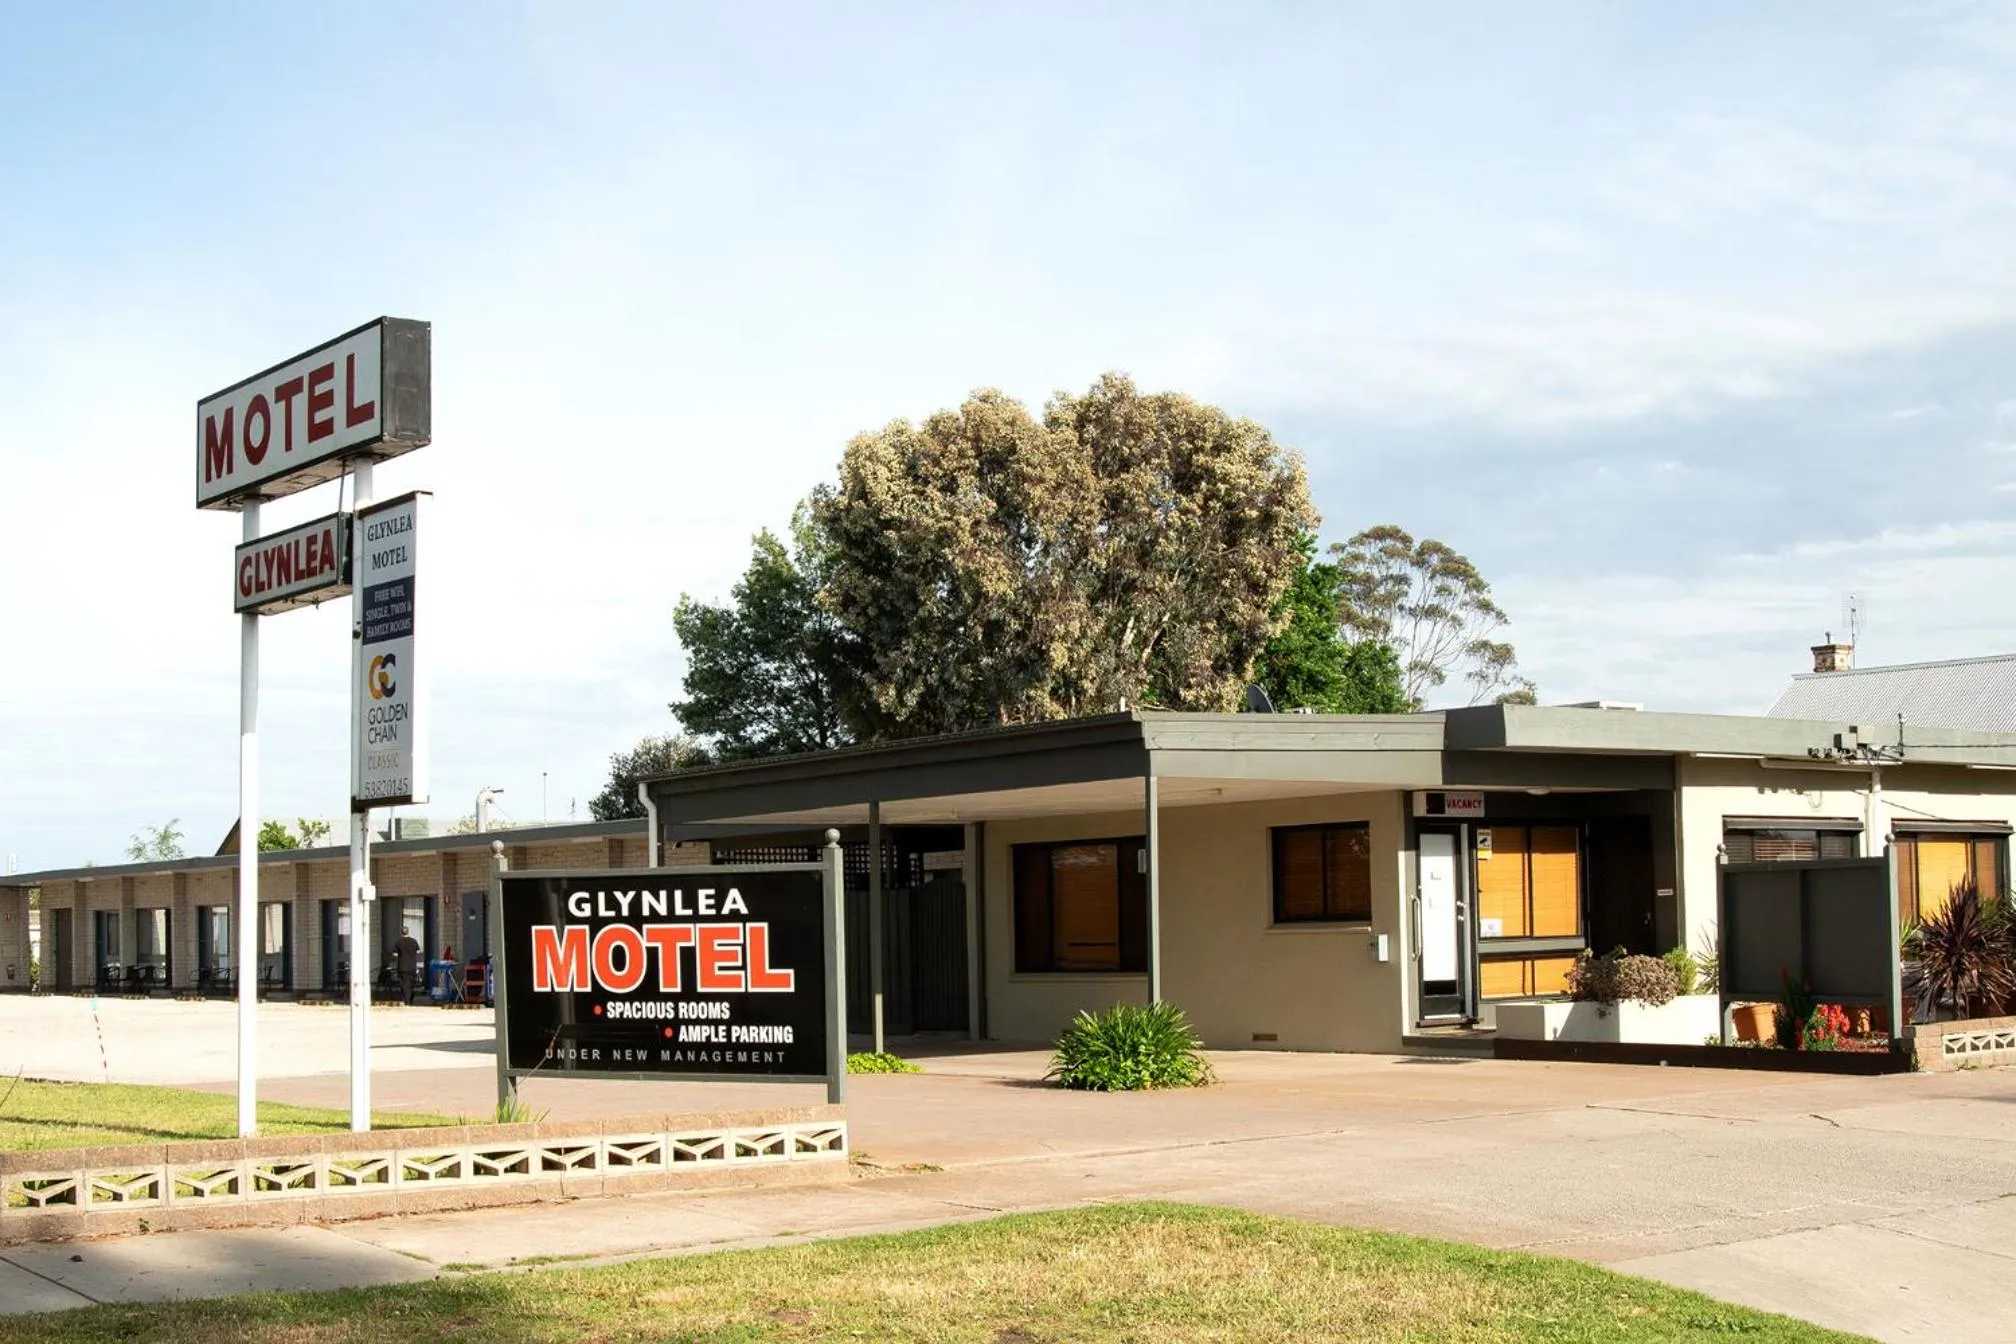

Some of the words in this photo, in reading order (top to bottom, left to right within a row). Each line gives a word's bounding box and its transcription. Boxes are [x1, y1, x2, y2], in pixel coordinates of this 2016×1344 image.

[205, 352, 375, 484] MOTEL
[367, 514, 413, 542] GLYNLEA
[239, 528, 336, 598] GLYNLEA
[372, 546, 408, 570] MOTEL
[368, 703, 408, 725] GOLDEN
[368, 725, 398, 744] CHAIN
[1446, 799, 1482, 809] VACANCY
[568, 888, 749, 917] GLYNLEA
[531, 922, 795, 993] MOTEL
[606, 1001, 675, 1020] SPACIOUS
[678, 1002, 731, 1020] ROOMS
[678, 1025, 727, 1043] AMPLE
[731, 1026, 794, 1044] PARKING
[546, 1049, 601, 1060] UNDER
[613, 1050, 648, 1061] NEW
[661, 1051, 786, 1063] MANAGEMENT
